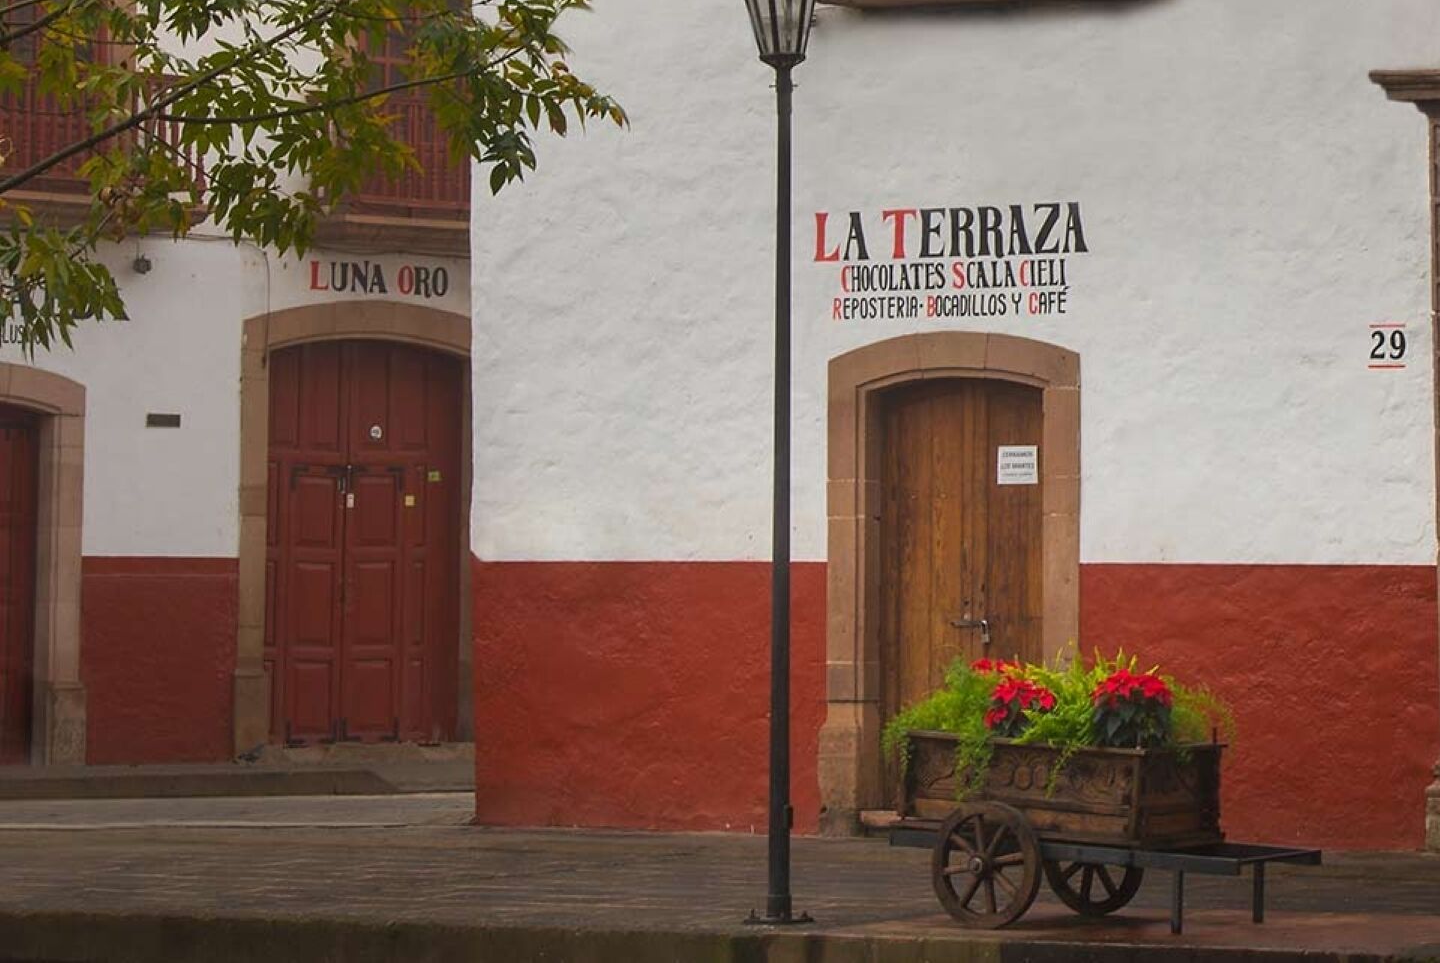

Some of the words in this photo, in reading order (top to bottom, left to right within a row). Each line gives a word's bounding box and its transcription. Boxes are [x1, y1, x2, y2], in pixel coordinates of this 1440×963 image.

[813, 212, 870, 262] LA
[882, 201, 1089, 260] TERRAZA
[309, 260, 388, 295] LUNA
[396, 264, 449, 299] ORO
[840, 262, 946, 293] CHOCOLATES
[951, 260, 1017, 290] SCALA
[1019, 258, 1067, 288] CIELI
[926, 293, 1007, 318] BOCADILLOS
[1011, 292, 1022, 315] Y
[1028, 285, 1070, 315] CAFÉ
[1370, 329, 1406, 360] 29
